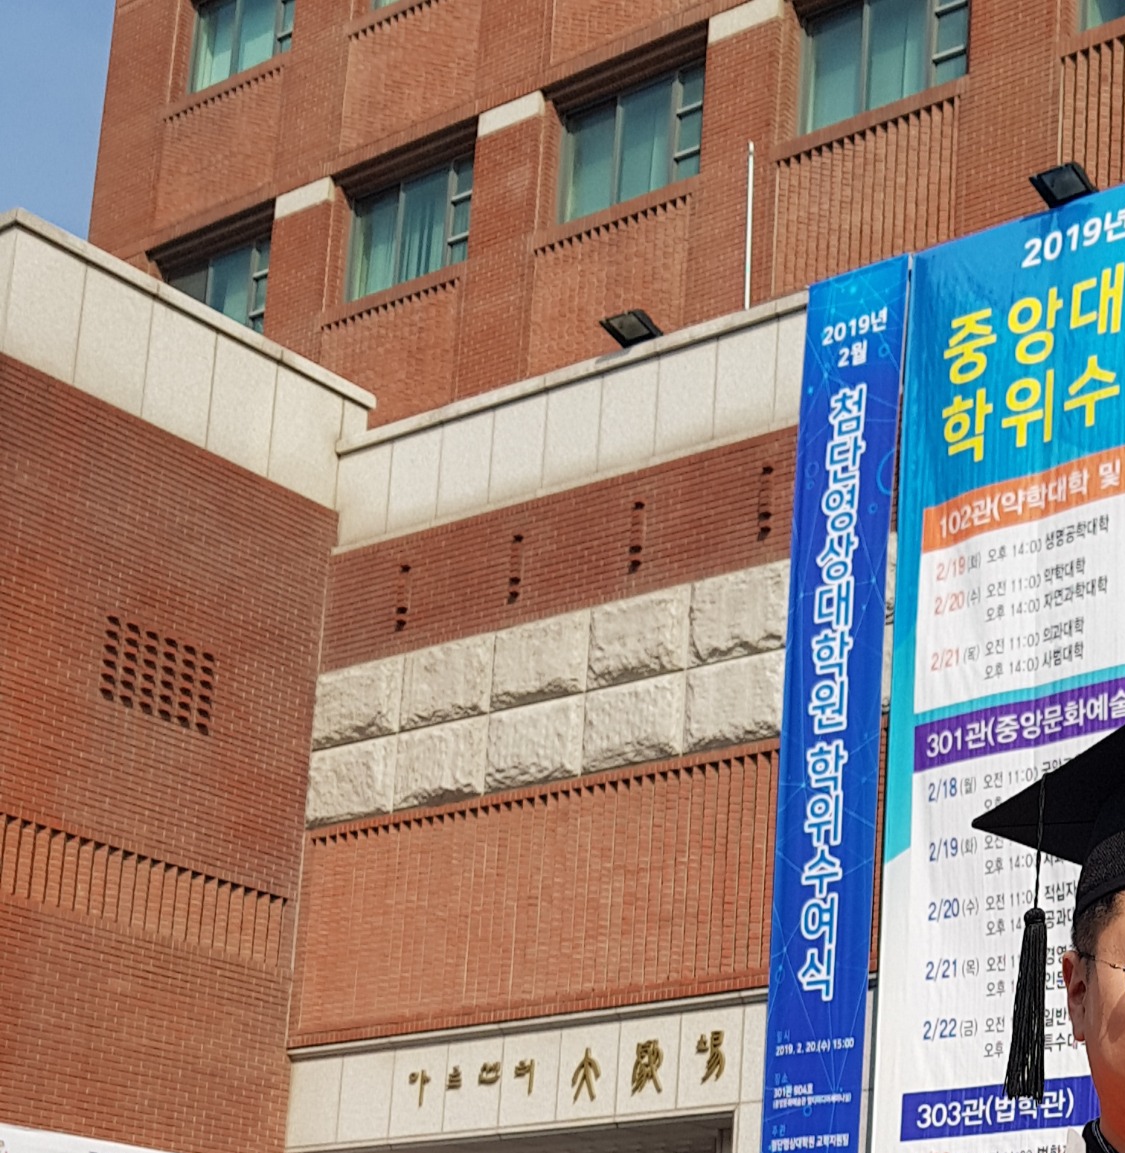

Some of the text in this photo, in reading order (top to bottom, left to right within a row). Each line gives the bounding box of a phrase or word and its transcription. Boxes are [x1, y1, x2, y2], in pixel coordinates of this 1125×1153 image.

[822, 306, 888, 346] 2019년
[837, 339, 868, 368] 2월
[939, 469, 1090, 538] 102관(약학대학
[1098, 459, 1120, 487] 및
[987, 546, 1007, 564] 오후
[1045, 514, 1109, 550] 생명공학대학
[809, 383, 868, 735] 첨단영상대학원
[986, 581, 1006, 598] 오전
[1044, 556, 1085, 583] 약학대학
[985, 604, 1005, 623] 오후
[1043, 575, 1107, 609] 자연과학대학
[985, 639, 1005, 657] 오전
[1043, 616, 1084, 643] 의과대학
[983, 664, 1004, 681] 오후
[1042, 641, 1084, 668] 사범대학
[928, 777, 957, 801] 2/18
[983, 771, 1003, 790] 오전
[929, 837, 958, 862] 2/19
[798, 739, 849, 1001] 학위수여식
[985, 857, 1004, 875] 오후
[928, 898, 960, 921] 2/20
[985, 895, 1005, 911] 오전
[986, 918, 1005, 936] 오후
[925, 960, 957, 980] 2/21
[986, 954, 1006, 972] 오전
[986, 979, 1005, 996] 오후
[833, 1037, 855, 1050] 15:00
[923, 1018, 957, 1041] 2/22
[985, 1017, 1005, 1033] 오전
[984, 1041, 1004, 1058] 오후
[916, 1087, 1075, 1129] 303관(법학관)
